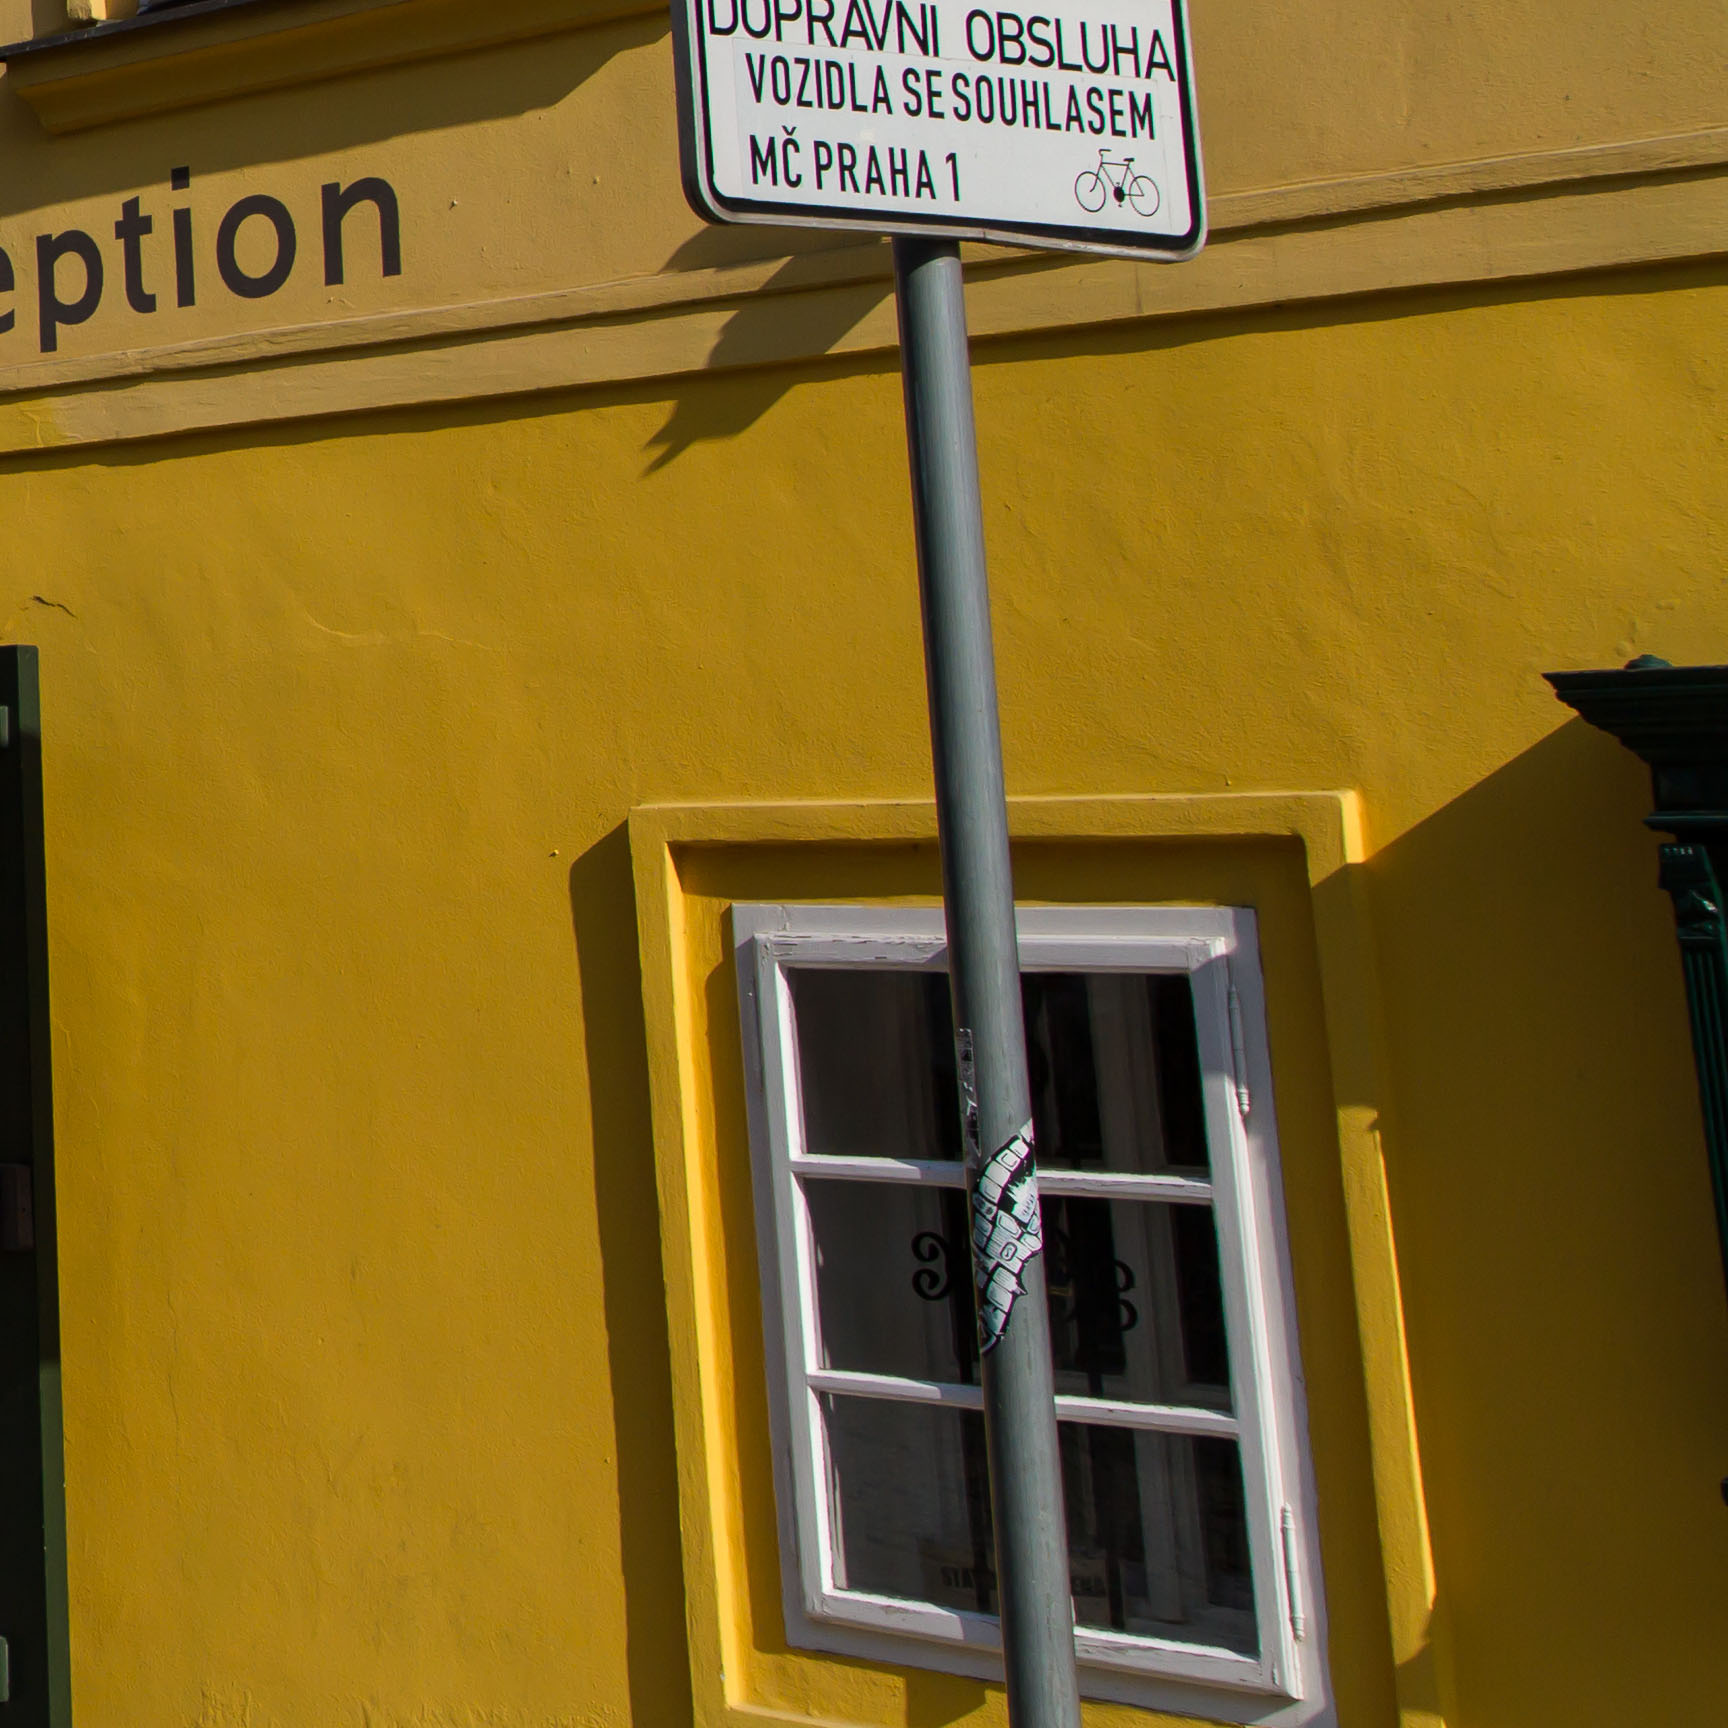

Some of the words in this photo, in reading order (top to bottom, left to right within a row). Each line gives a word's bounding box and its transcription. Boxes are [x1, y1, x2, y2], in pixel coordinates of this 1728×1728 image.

[965, 9, 1176, 82] OBSLUHA
[745, 52, 893, 115] VOZIDLA
[902, 68, 945, 119] SE
[952, 72, 1156, 140] SOUHLASEM
[749, 125, 802, 188] MČ
[813, 140, 937, 201] PRAHA
[945, 152, 960, 202] 1
